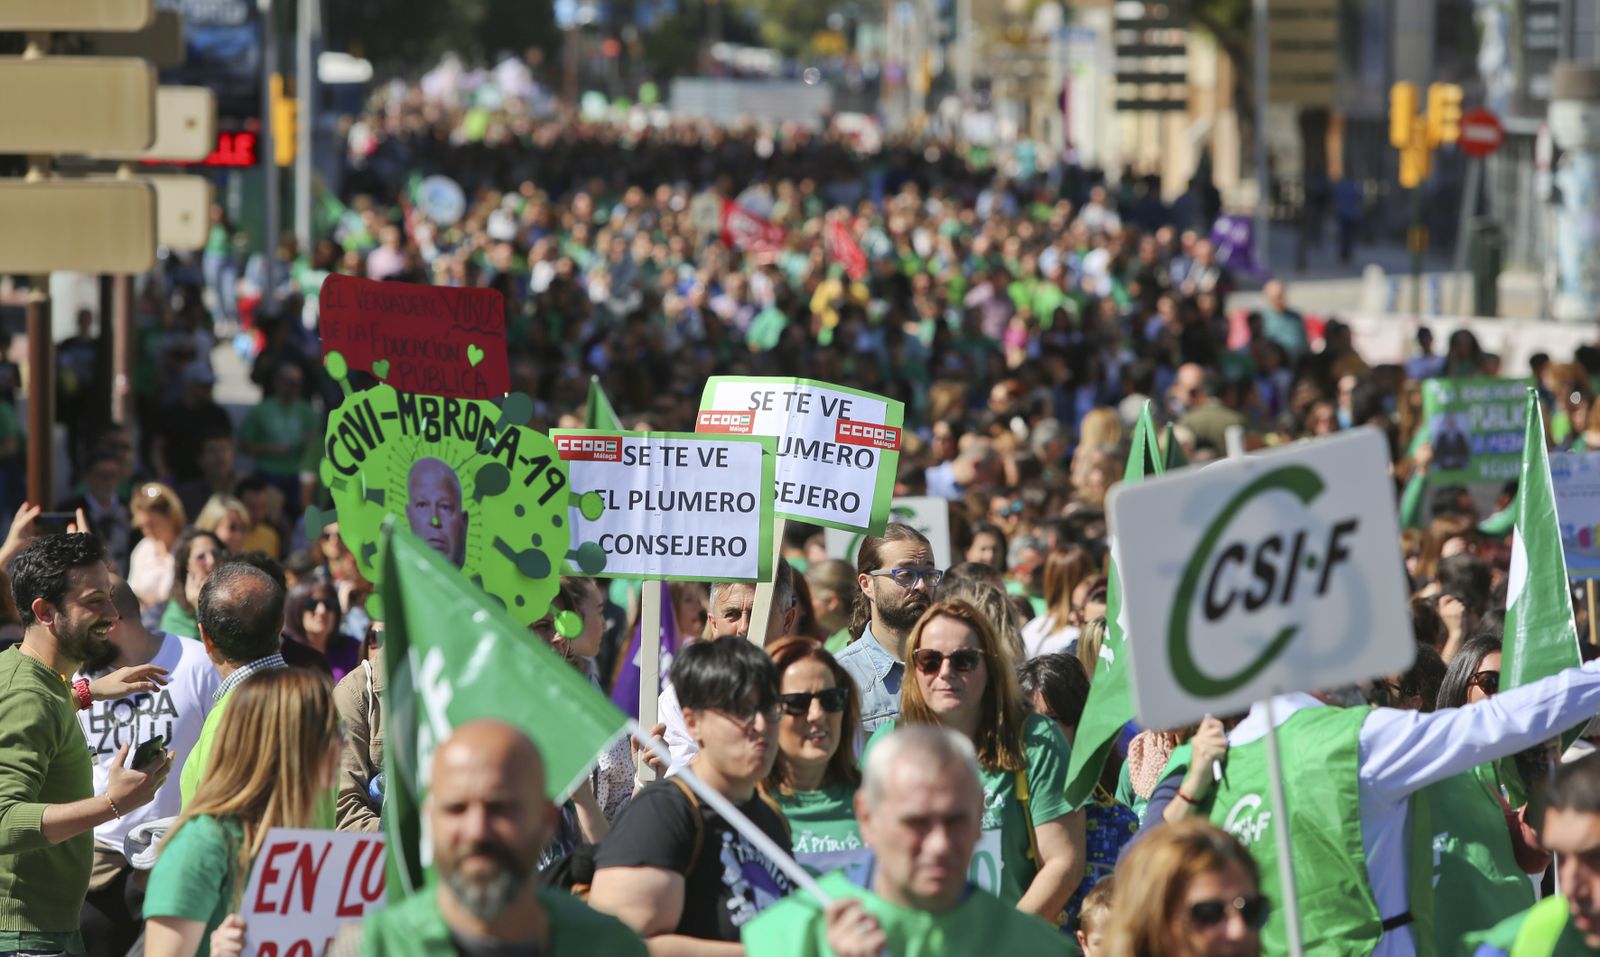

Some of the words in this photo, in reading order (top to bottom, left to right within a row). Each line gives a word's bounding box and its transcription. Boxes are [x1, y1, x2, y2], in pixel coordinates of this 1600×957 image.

[326, 278, 347, 308] EL
[440, 289, 504, 328] VIRUS
[748, 390, 776, 412] SE
[783, 391, 812, 414] TE
[820, 395, 853, 421] VE
[593, 452, 618, 460] Málaga
[623, 445, 650, 467] SE
[659, 446, 689, 467] TE
[697, 446, 729, 468] VE
[628, 489, 756, 514] PLUMERO
[599, 533, 748, 558] CONSEJERO
[88, 689, 180, 732] HORA
[252, 841, 334, 916] EN
